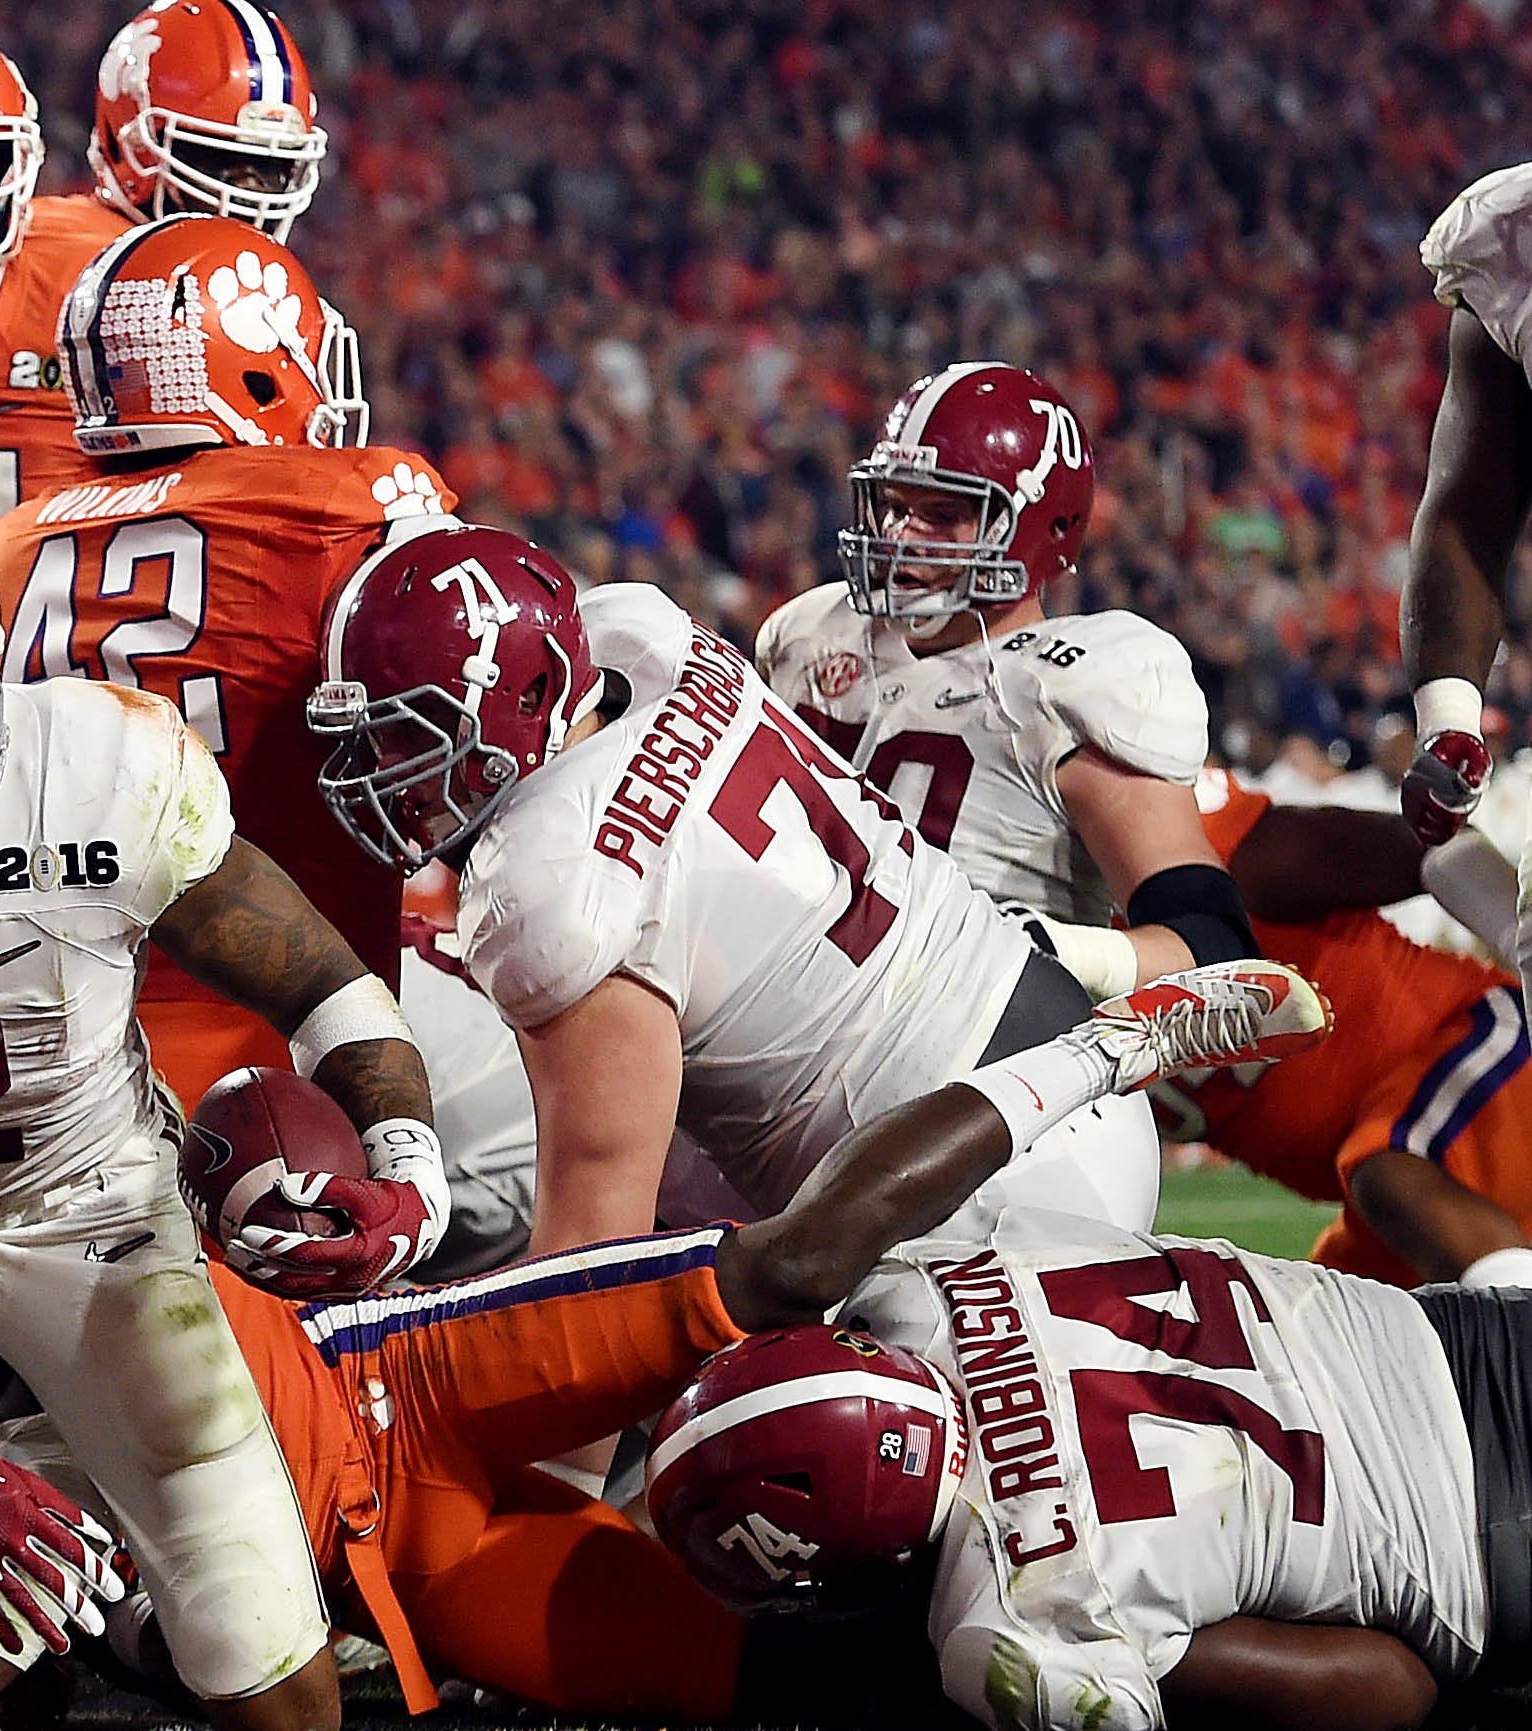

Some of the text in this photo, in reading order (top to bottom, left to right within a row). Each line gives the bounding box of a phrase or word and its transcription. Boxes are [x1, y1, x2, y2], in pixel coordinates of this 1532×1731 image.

[1029, 398, 1082, 470] 70
[2, 512, 226, 755] 42
[430, 557, 520, 640] 71
[927, 1248, 1079, 1568] C. ROBINSON
[1036, 1247, 1327, 1527] 74
[879, 1431, 903, 1461] 28
[716, 1512, 821, 1581] 74
